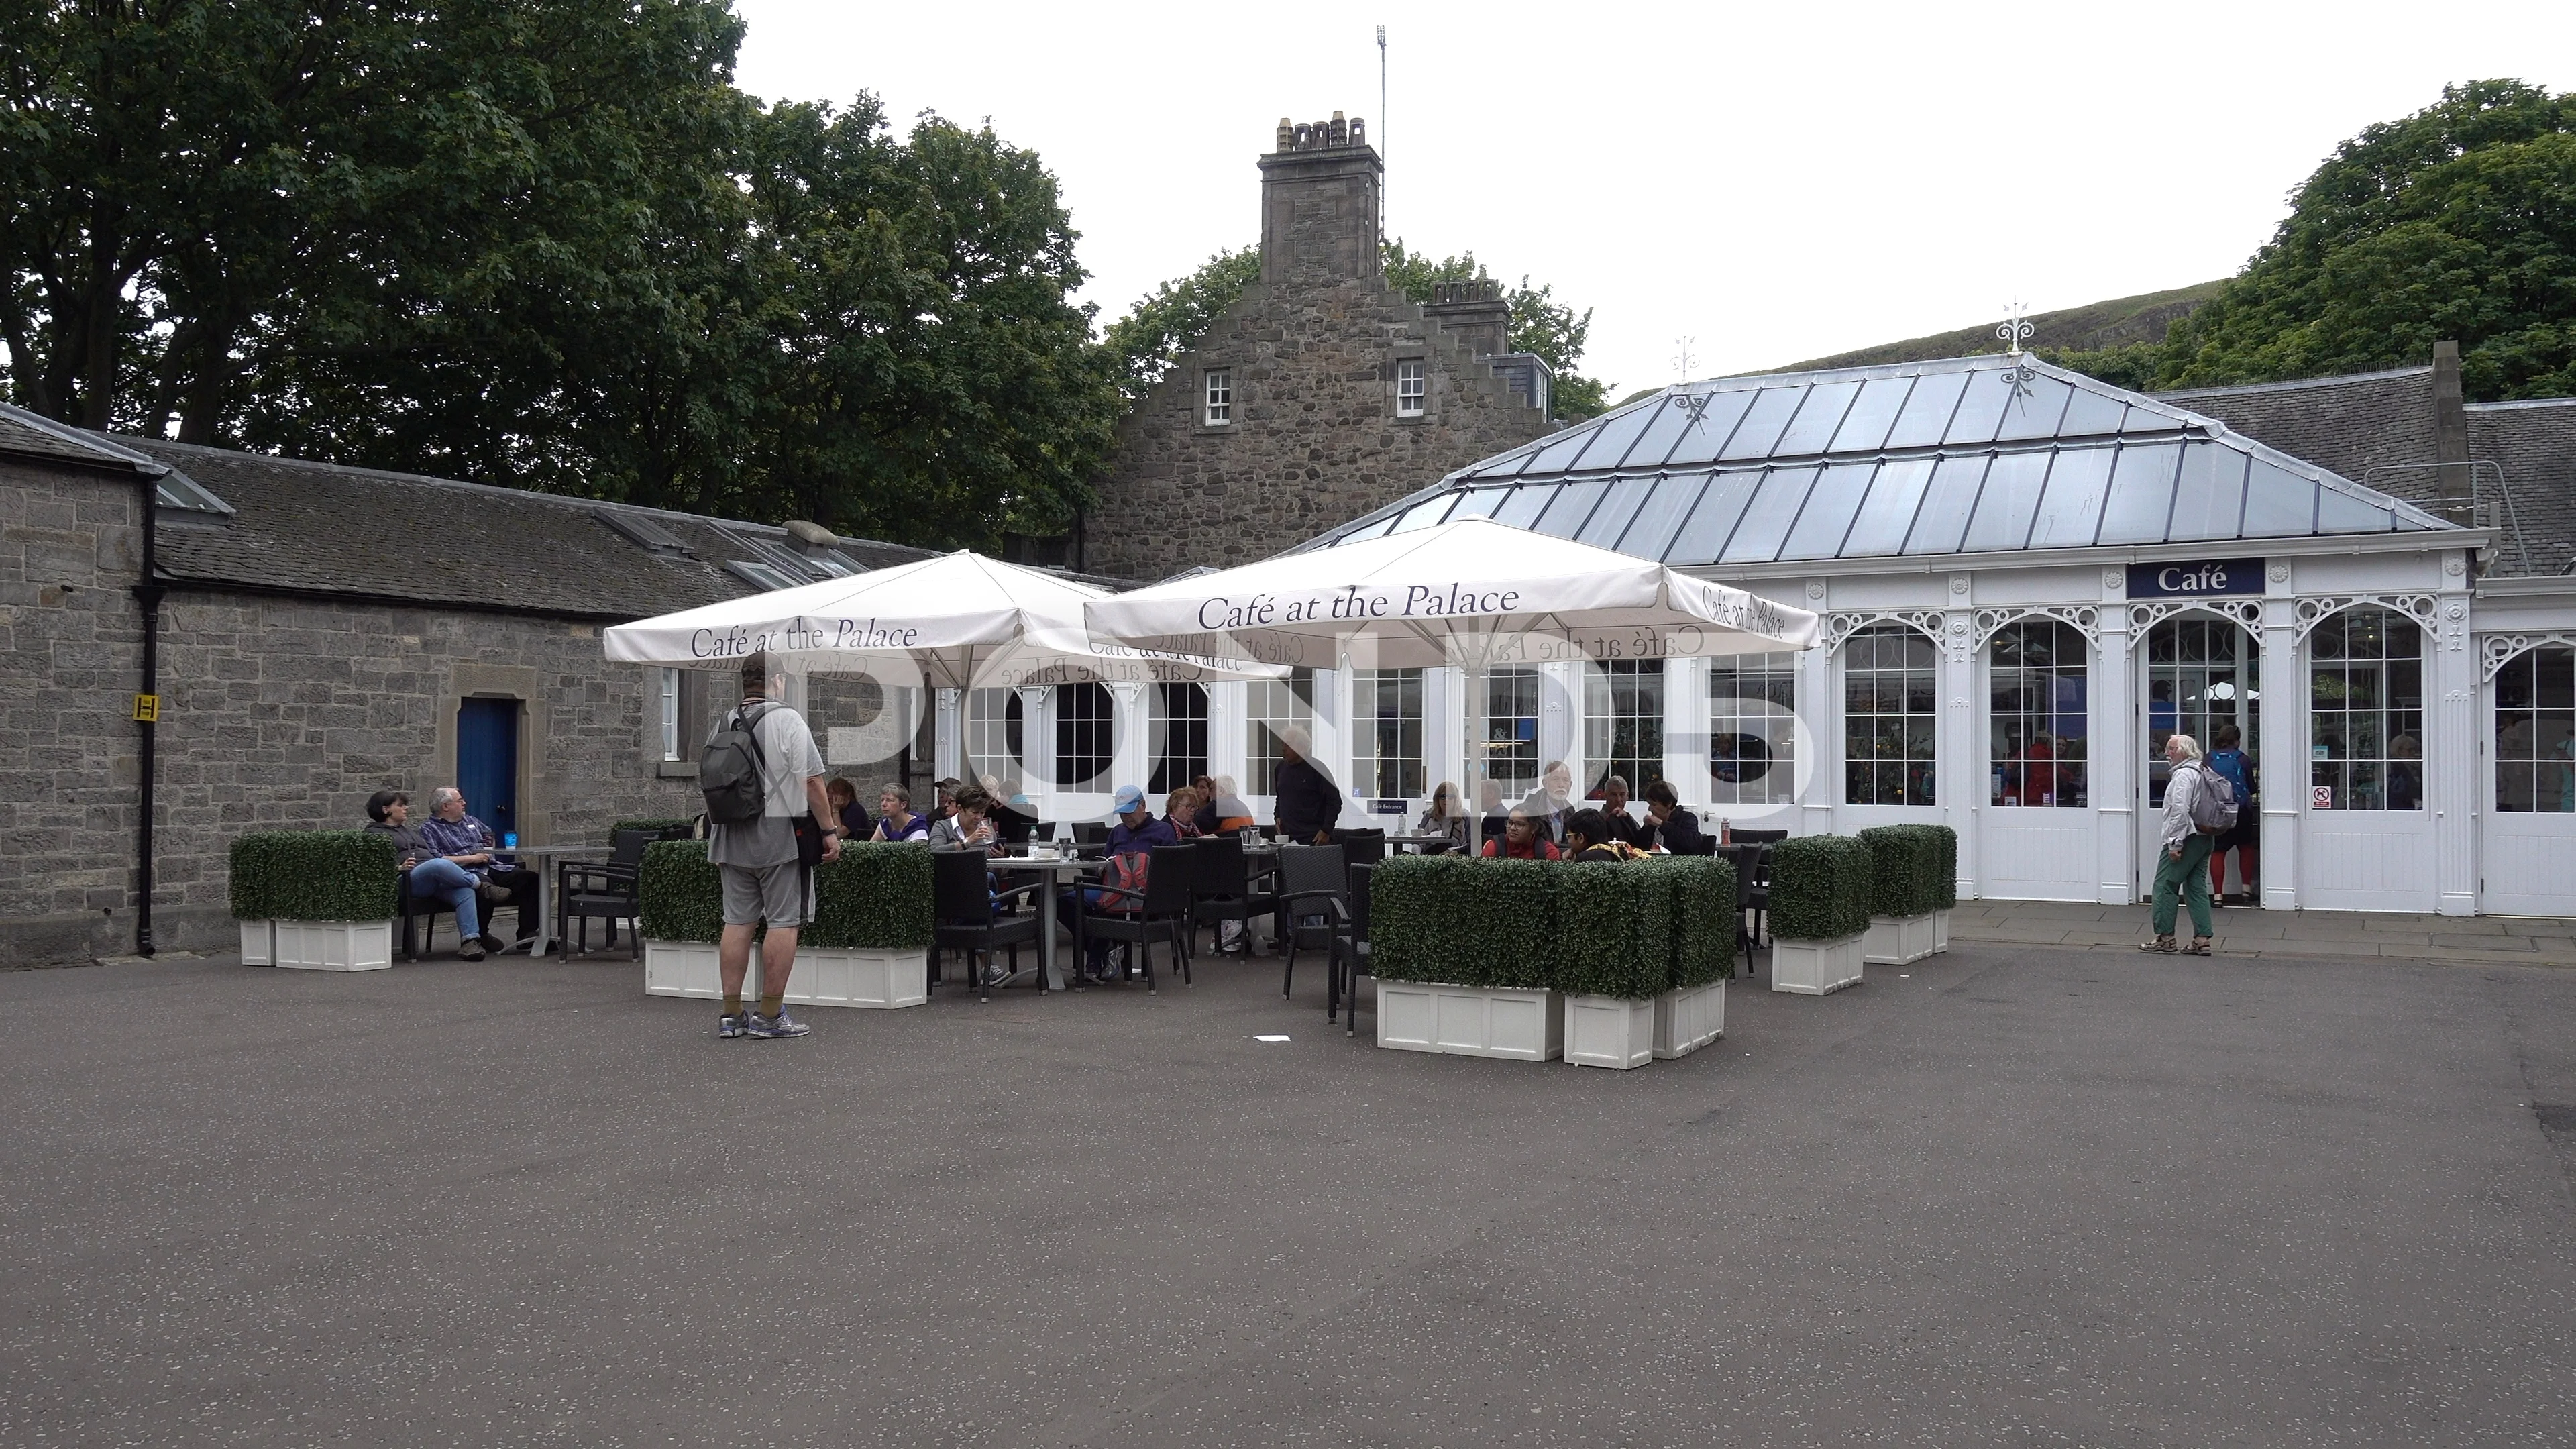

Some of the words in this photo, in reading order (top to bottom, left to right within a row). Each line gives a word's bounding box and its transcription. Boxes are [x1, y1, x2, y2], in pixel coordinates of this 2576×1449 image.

[2157, 564, 2227, 592] Café
[1198, 594, 1275, 630] Café
[1285, 598, 1321, 622] at
[1331, 584, 1389, 619] the
[1401, 582, 1519, 616] Palace
[1703, 586, 1731, 625] Café
[1732, 602, 1745, 627] at
[1756, 601, 1785, 639] Palace
[691, 625, 749, 657] Café
[754, 630, 778, 653] at
[787, 616, 824, 650] the
[832, 618, 918, 648] Palace
[1372, 802, 1382, 810] Café
